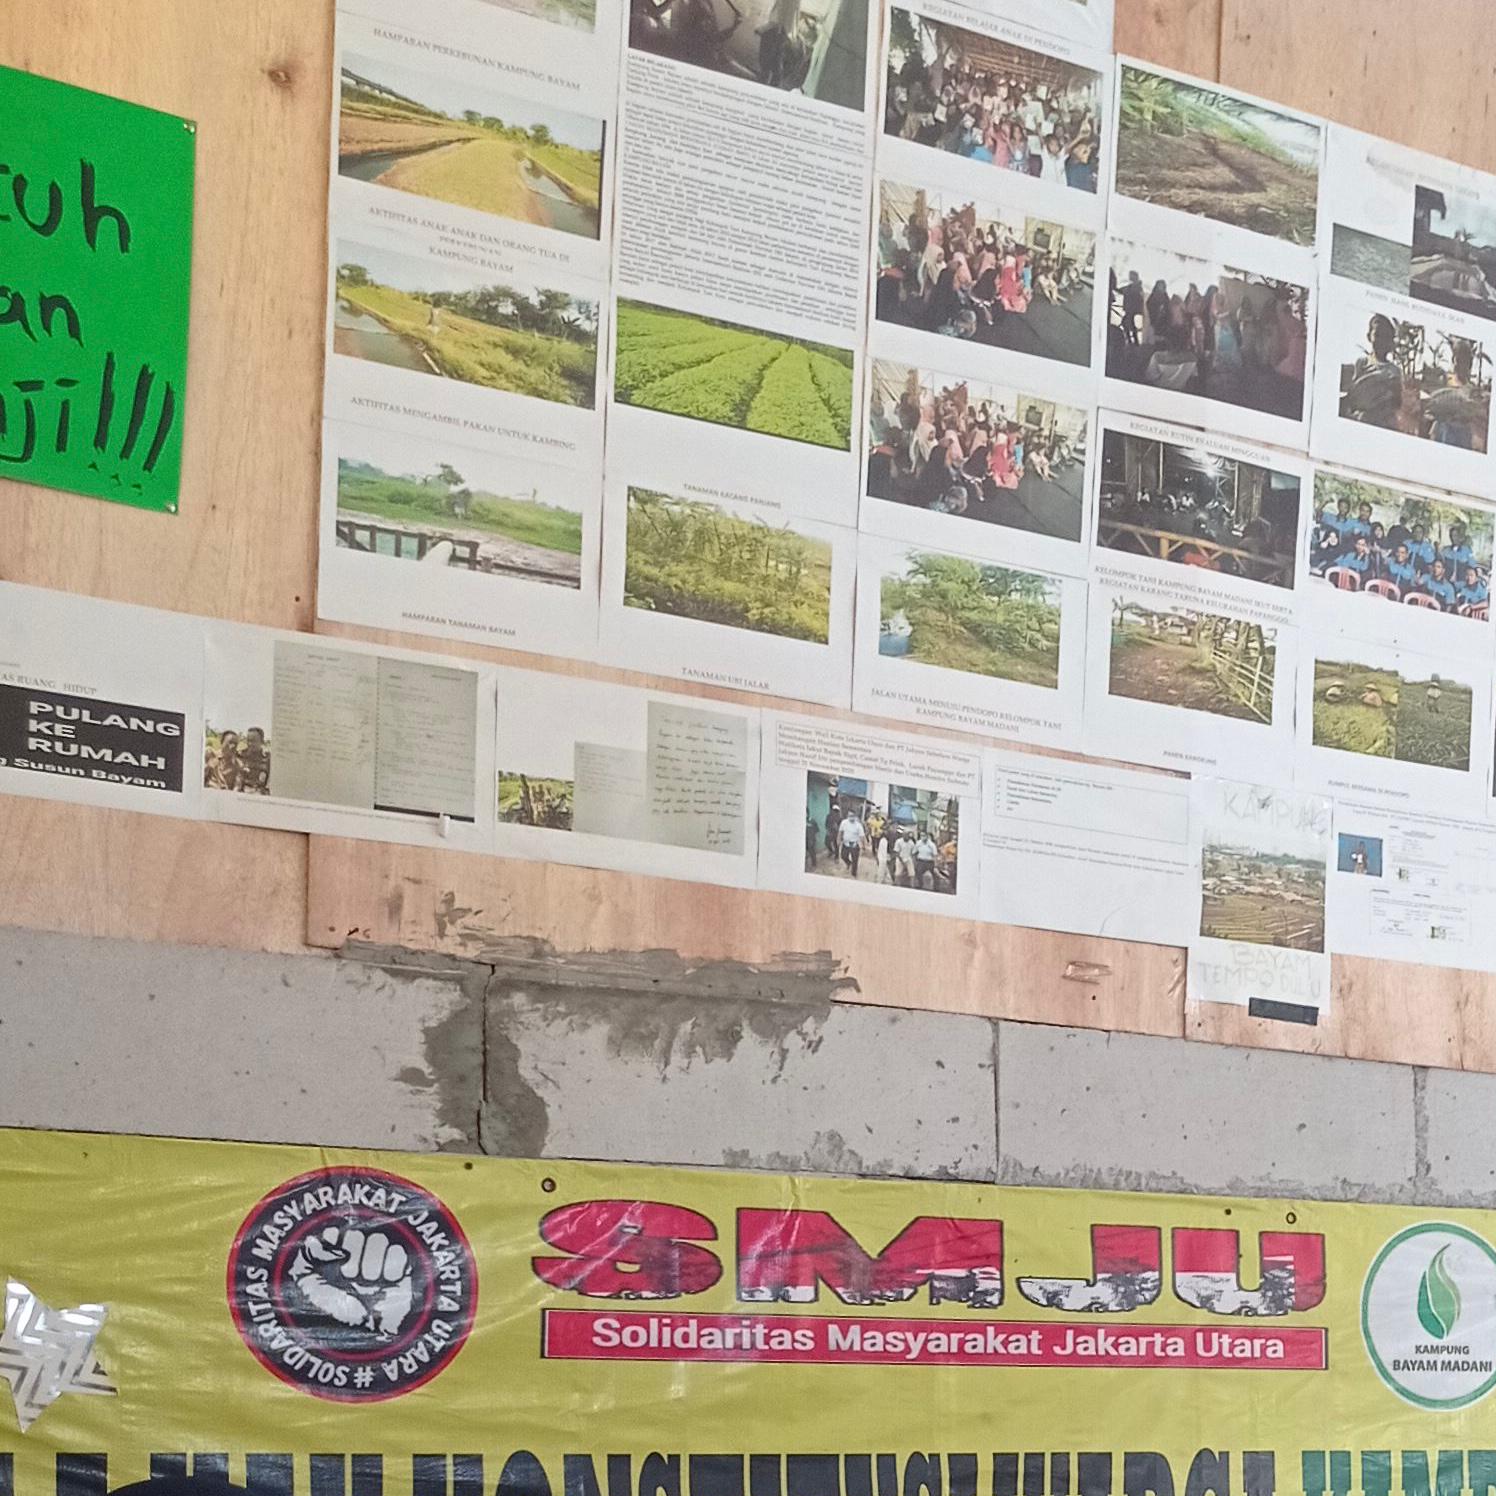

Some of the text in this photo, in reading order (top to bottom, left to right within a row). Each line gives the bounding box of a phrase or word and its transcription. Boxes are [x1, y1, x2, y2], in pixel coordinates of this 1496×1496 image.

[374, 28, 580, 90] HAMPARAN PERKEBUNAN KAMPUNG BAYAM
[0, 157, 131, 253] uh
[419, 219, 448, 234] ANAK
[451, 226, 477, 241] ANAK
[479, 230, 500, 244] DAN
[502, 238, 537, 254] ORANG
[539, 247, 557, 260] TUA
[428, 246, 514, 273] KAMPUNG BAYAM
[403, 406, 461, 427] MENGAMBIL
[463, 419, 496, 434] PAKAN
[497, 427, 531, 442] UNTUK
[17, 675, 56, 690] RUANG
[63, 683, 97, 695] HIDUP
[28, 701, 181, 737] PULANG
[28, 719, 76, 739] KE
[27, 737, 166, 770] RUMAH
[14, 757, 166, 788] Susun Bayam
[531, 1199, 1327, 1317] SMJU
[246, 1183, 462, 1387] SOLIDARITAS MASYARAKAT JAKARTA UTARA
[592, 1317, 1285, 1360] Solidaritas Masyarakat Jakarta Utara
[1414, 1344, 1470, 1357] KAMPUNG
[1391, 1358, 1493, 1374] BAYAM MADANI
